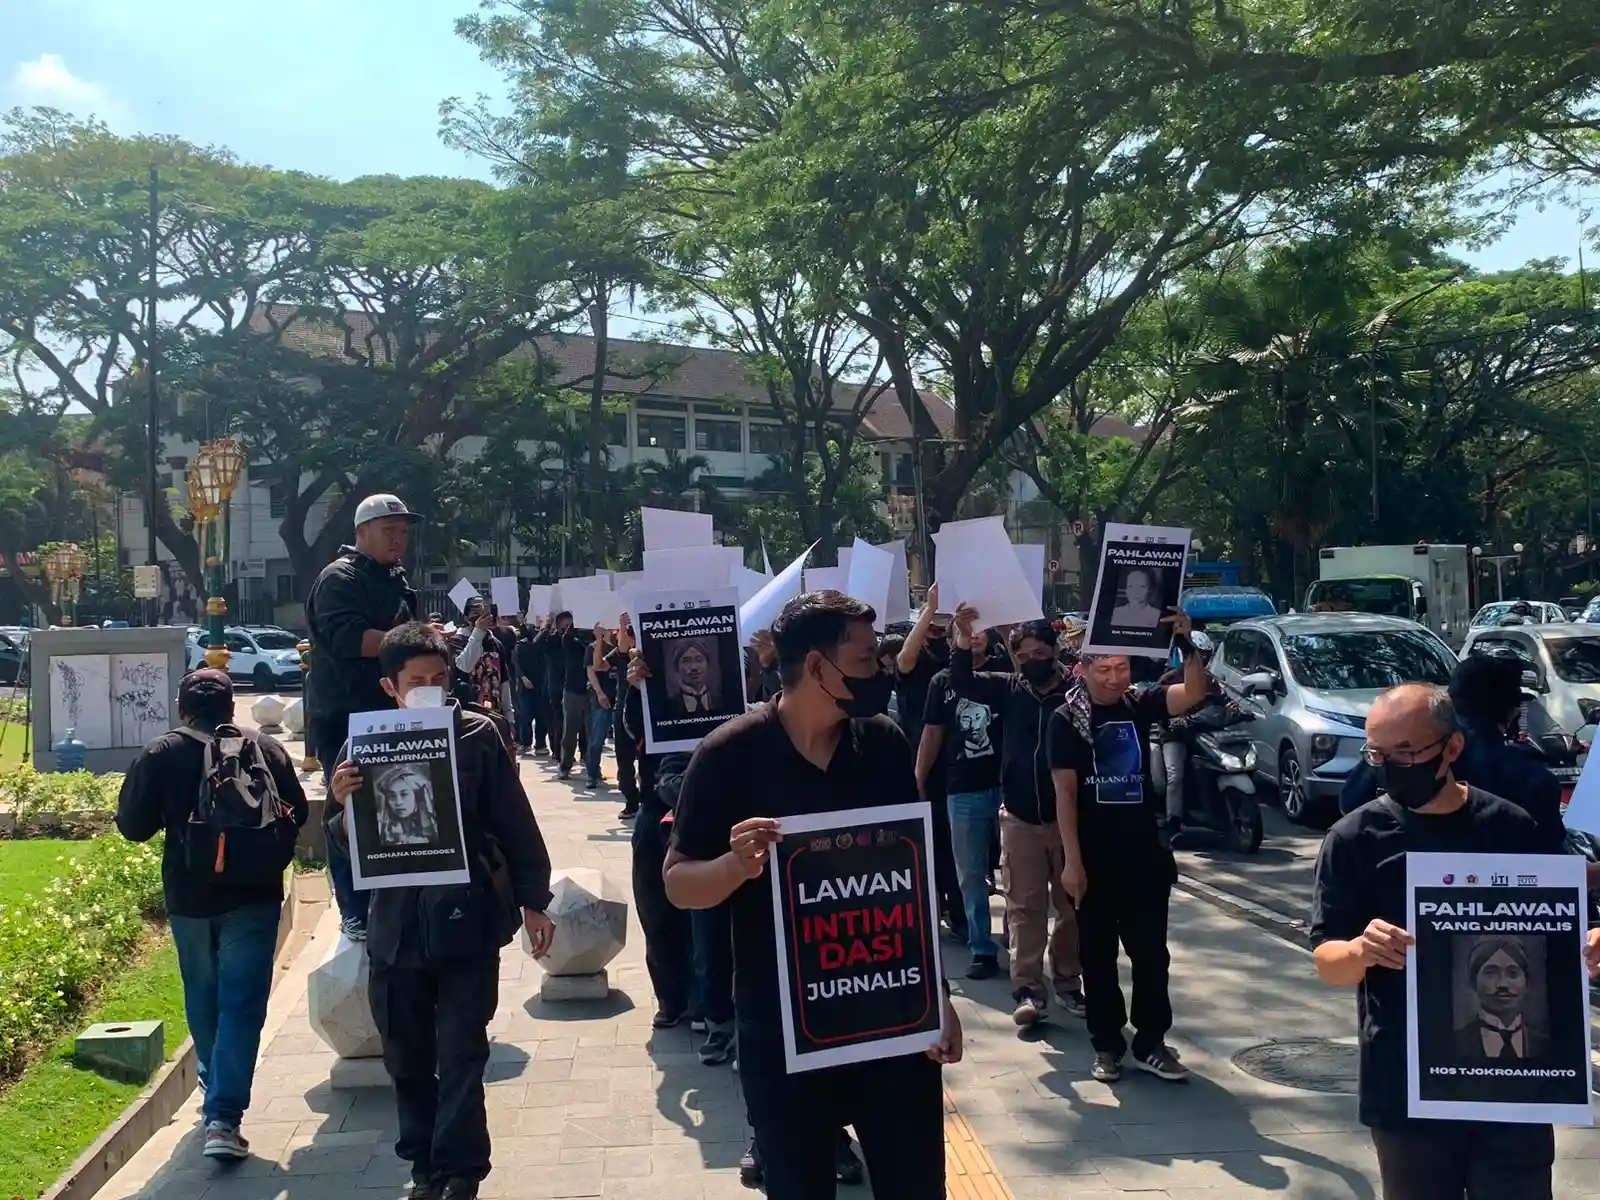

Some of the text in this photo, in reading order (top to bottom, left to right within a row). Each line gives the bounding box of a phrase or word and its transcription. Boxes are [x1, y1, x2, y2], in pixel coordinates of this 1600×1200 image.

[1107, 548, 1182, 559] PAHLAWAN
[642, 614, 734, 631] PAHLAWAN
[650, 627, 733, 639] YANG JURNALIS
[352, 738, 448, 756] PAHLAWAN
[358, 751, 447, 765] YANG JURNALIS
[1084, 775, 1128, 785] MALANG
[367, 851, 409, 860] ROEHANA
[798, 868, 912, 904] LAWAN
[1419, 901, 1576, 916] PAHLAWAN
[802, 903, 914, 944] INTIMI
[1431, 921, 1573, 931] YANG JURNALIS
[818, 933, 904, 970] DASI
[807, 966, 921, 1001] JURNALIS
[1429, 1066, 1577, 1077] HOS TJOKROAMINOTO
